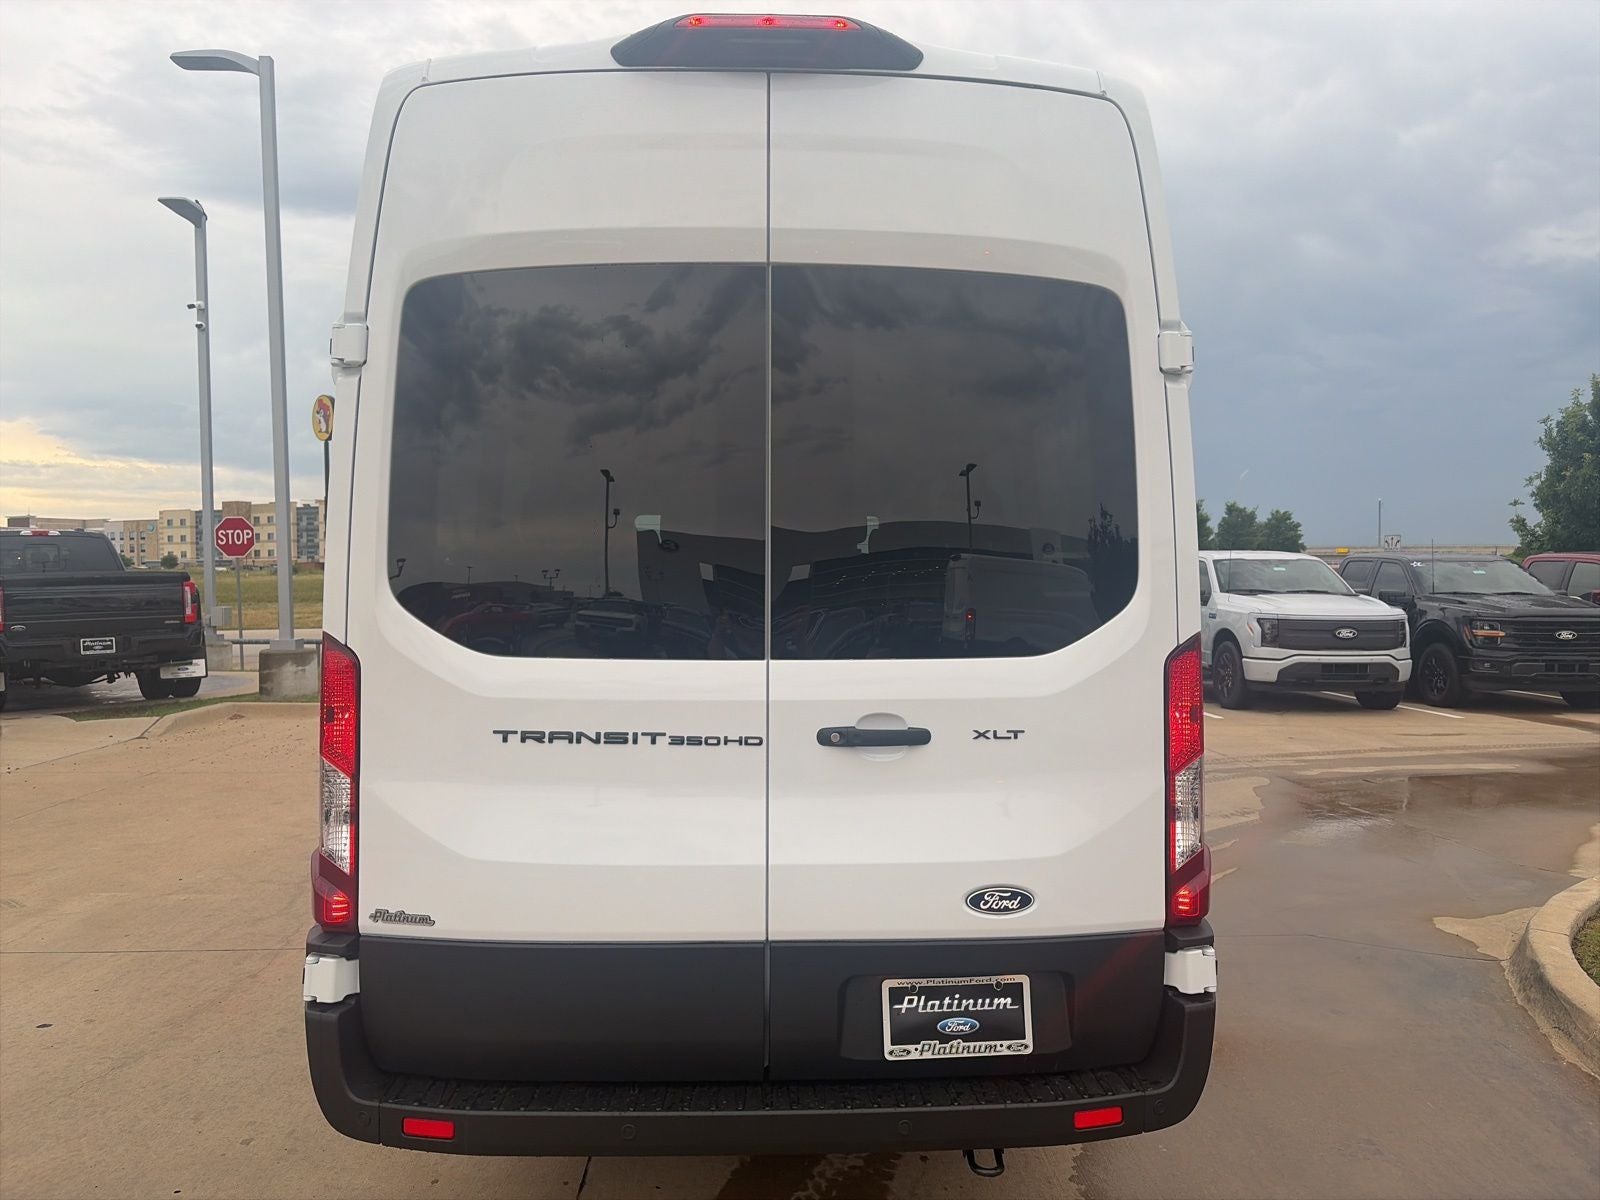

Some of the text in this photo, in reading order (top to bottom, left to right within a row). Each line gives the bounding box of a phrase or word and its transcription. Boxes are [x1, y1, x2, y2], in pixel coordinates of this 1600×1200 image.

[217, 529, 253, 545] STOP
[492, 729, 667, 746] TRANSIT
[972, 730, 1025, 740] XLT
[979, 891, 1022, 910] Ford
[368, 908, 436, 926] Platinum
[896, 976, 1016, 986] www.PlatinumFord.com
[892, 993, 1020, 1014] Platinum
[919, 1041, 1002, 1056] Platinum
